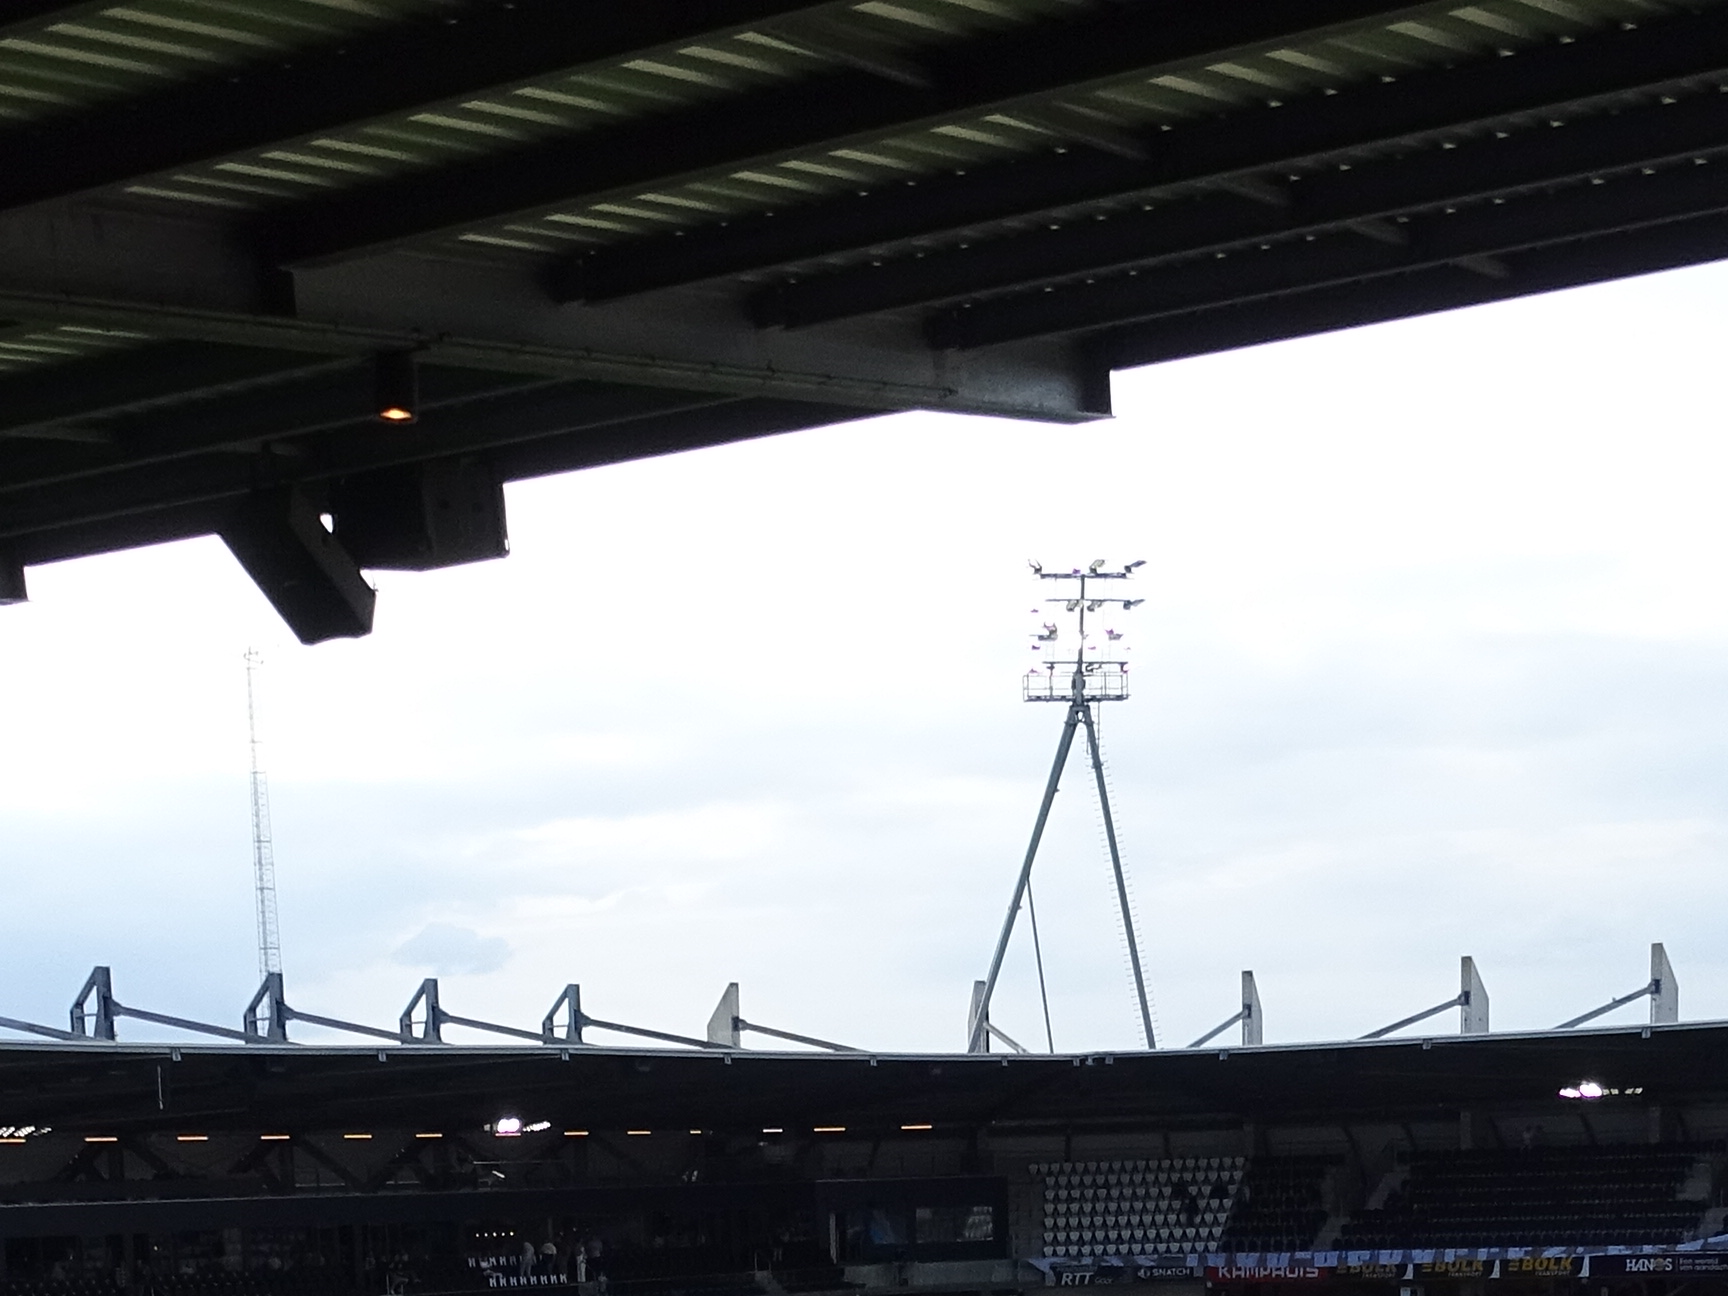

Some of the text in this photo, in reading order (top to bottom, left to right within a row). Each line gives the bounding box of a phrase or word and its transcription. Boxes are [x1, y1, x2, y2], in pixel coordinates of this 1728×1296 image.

[1435, 1260, 1483, 1271] BOLK
[1521, 1257, 1574, 1271] BOLK
[1624, 1258, 1672, 1272] HANOS
[1060, 1272, 1094, 1286] RTT
[1152, 1267, 1190, 1277] SNATCH
